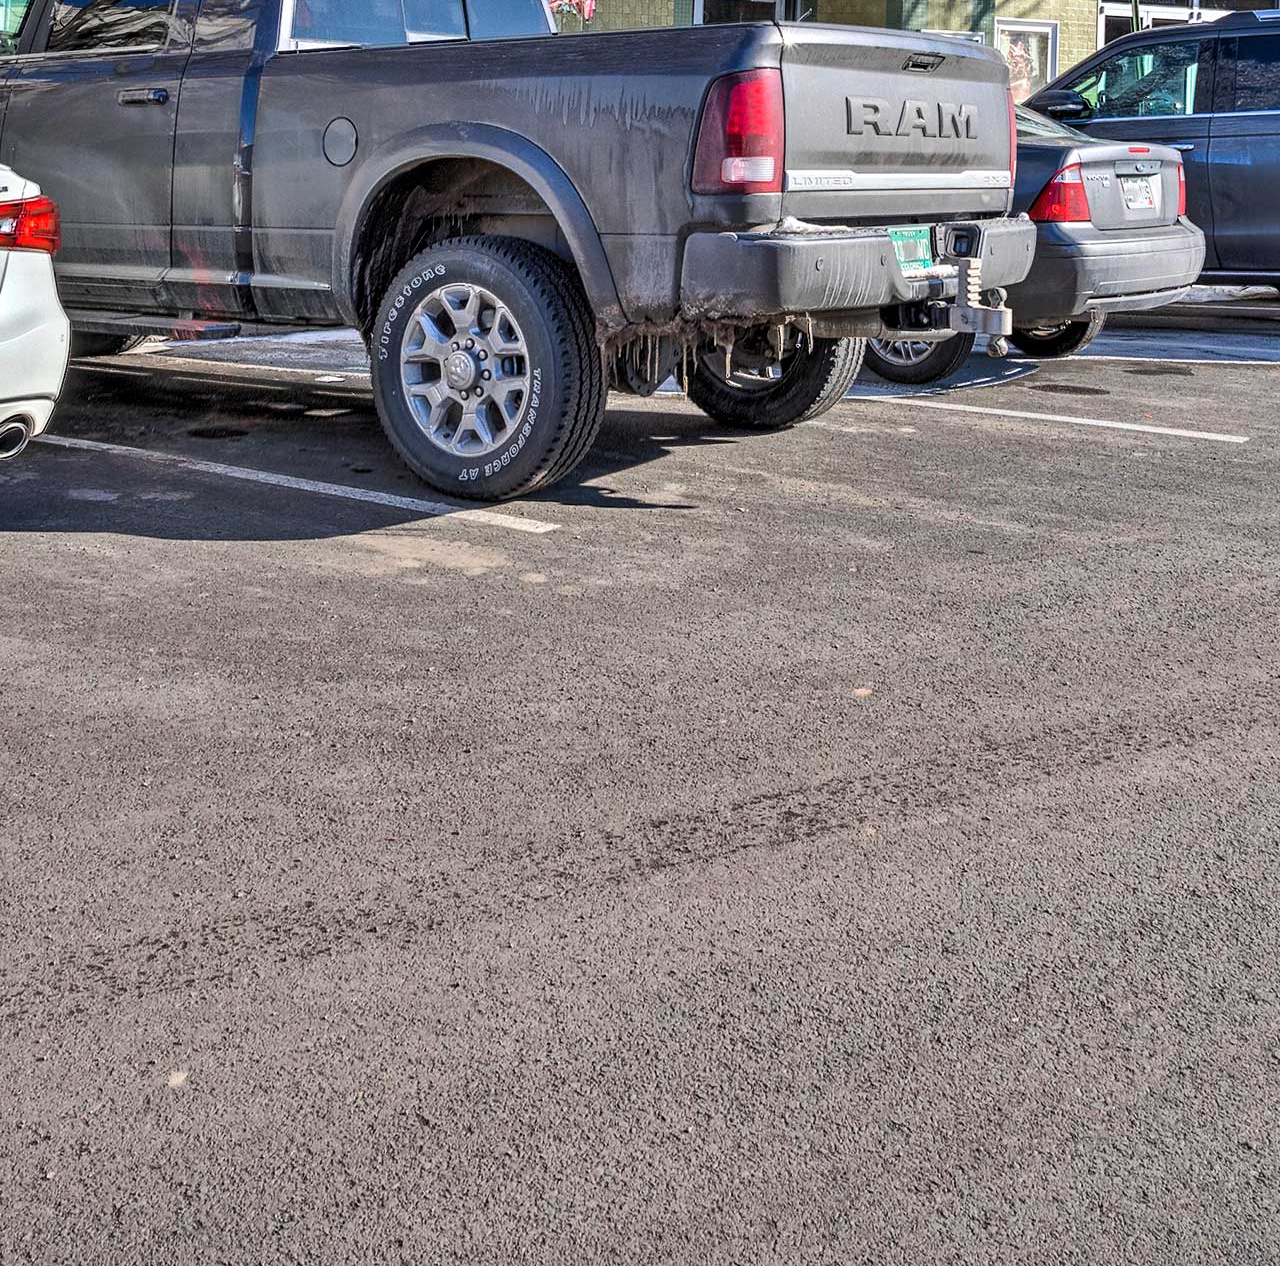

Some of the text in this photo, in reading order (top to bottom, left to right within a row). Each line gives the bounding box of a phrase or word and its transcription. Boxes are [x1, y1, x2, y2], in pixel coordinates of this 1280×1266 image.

[845, 95, 978, 140] RAM
[793, 175, 854, 187] LIMITED
[458, 367, 543, 482] TRANSFORCE AT
